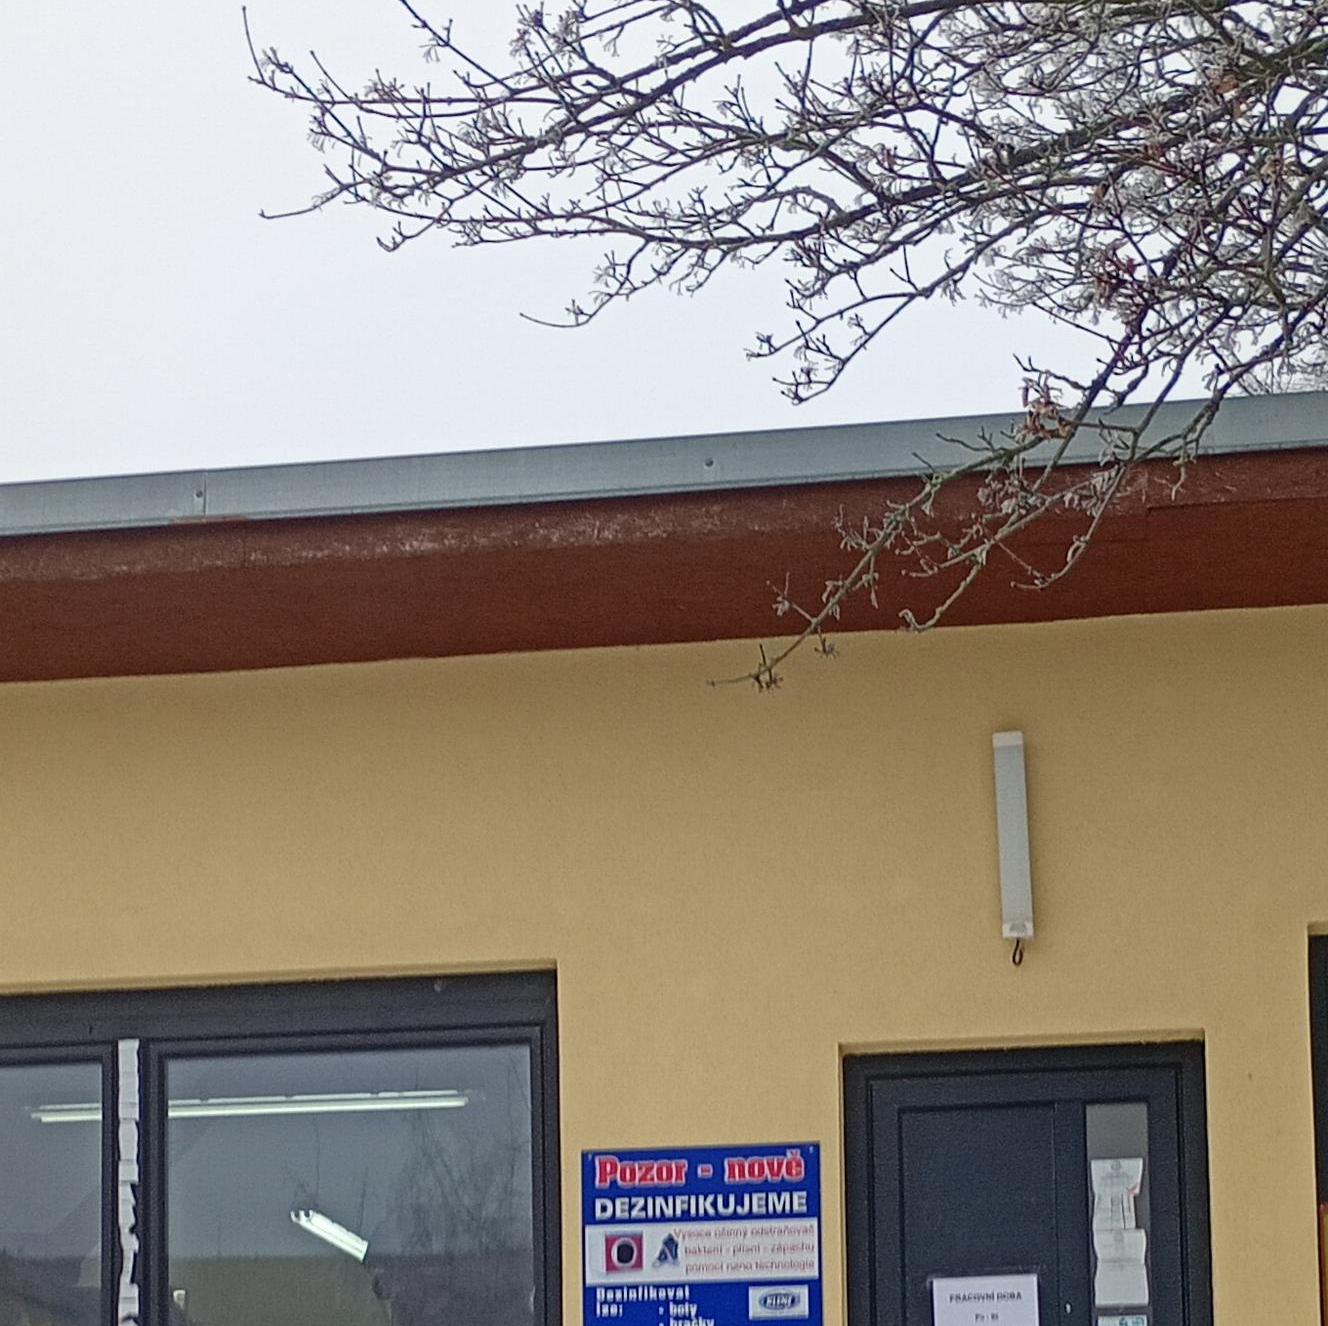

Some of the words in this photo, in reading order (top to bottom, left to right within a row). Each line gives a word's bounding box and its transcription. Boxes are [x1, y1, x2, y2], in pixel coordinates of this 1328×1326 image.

[595, 1154, 688, 1188] Pozor
[724, 1149, 804, 1183] nově
[595, 1190, 808, 1220] DEZINFIKUJEME
[670, 1302, 697, 1317] boty
